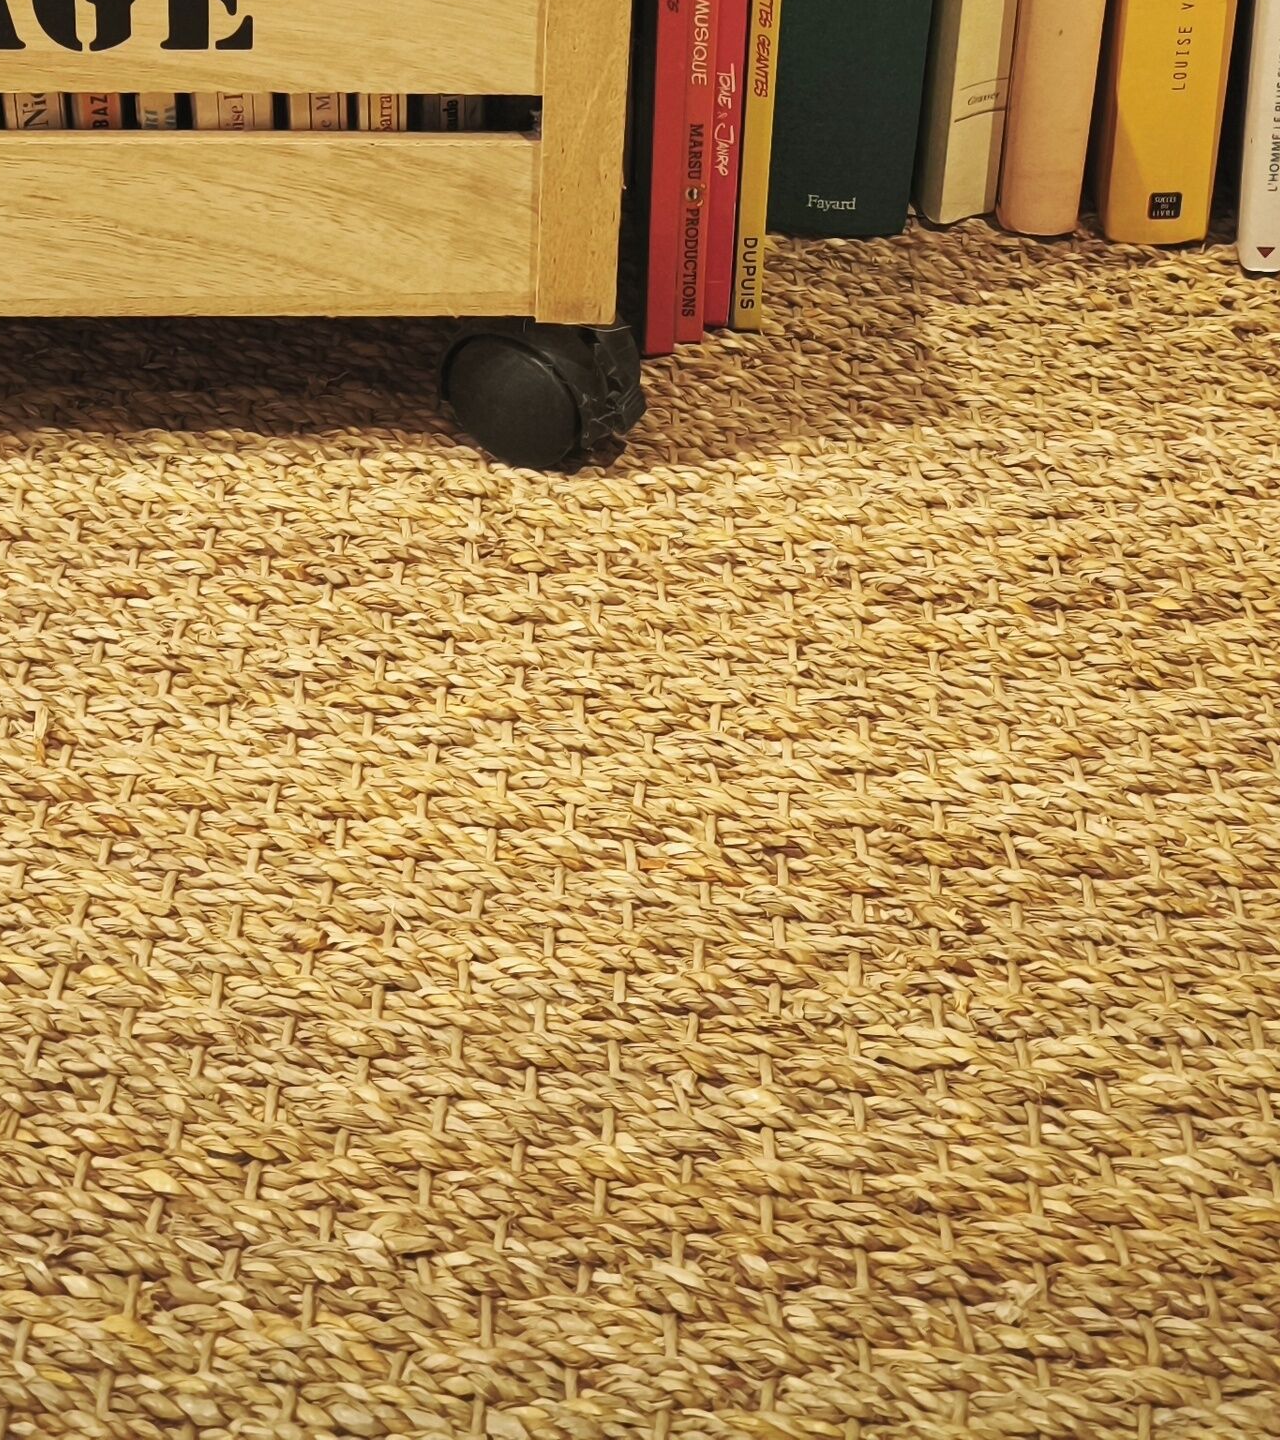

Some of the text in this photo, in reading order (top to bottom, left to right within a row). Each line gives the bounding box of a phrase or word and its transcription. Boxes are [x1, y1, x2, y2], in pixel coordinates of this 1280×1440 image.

[691, 5, 710, 87] MUSIQUE
[1171, 25, 1193, 91] LOUISE
[682, 124, 704, 317] MARSU PRODUCTIONS
[807, 194, 857, 212] Fayard
[741, 237, 758, 310] DUPUIS
